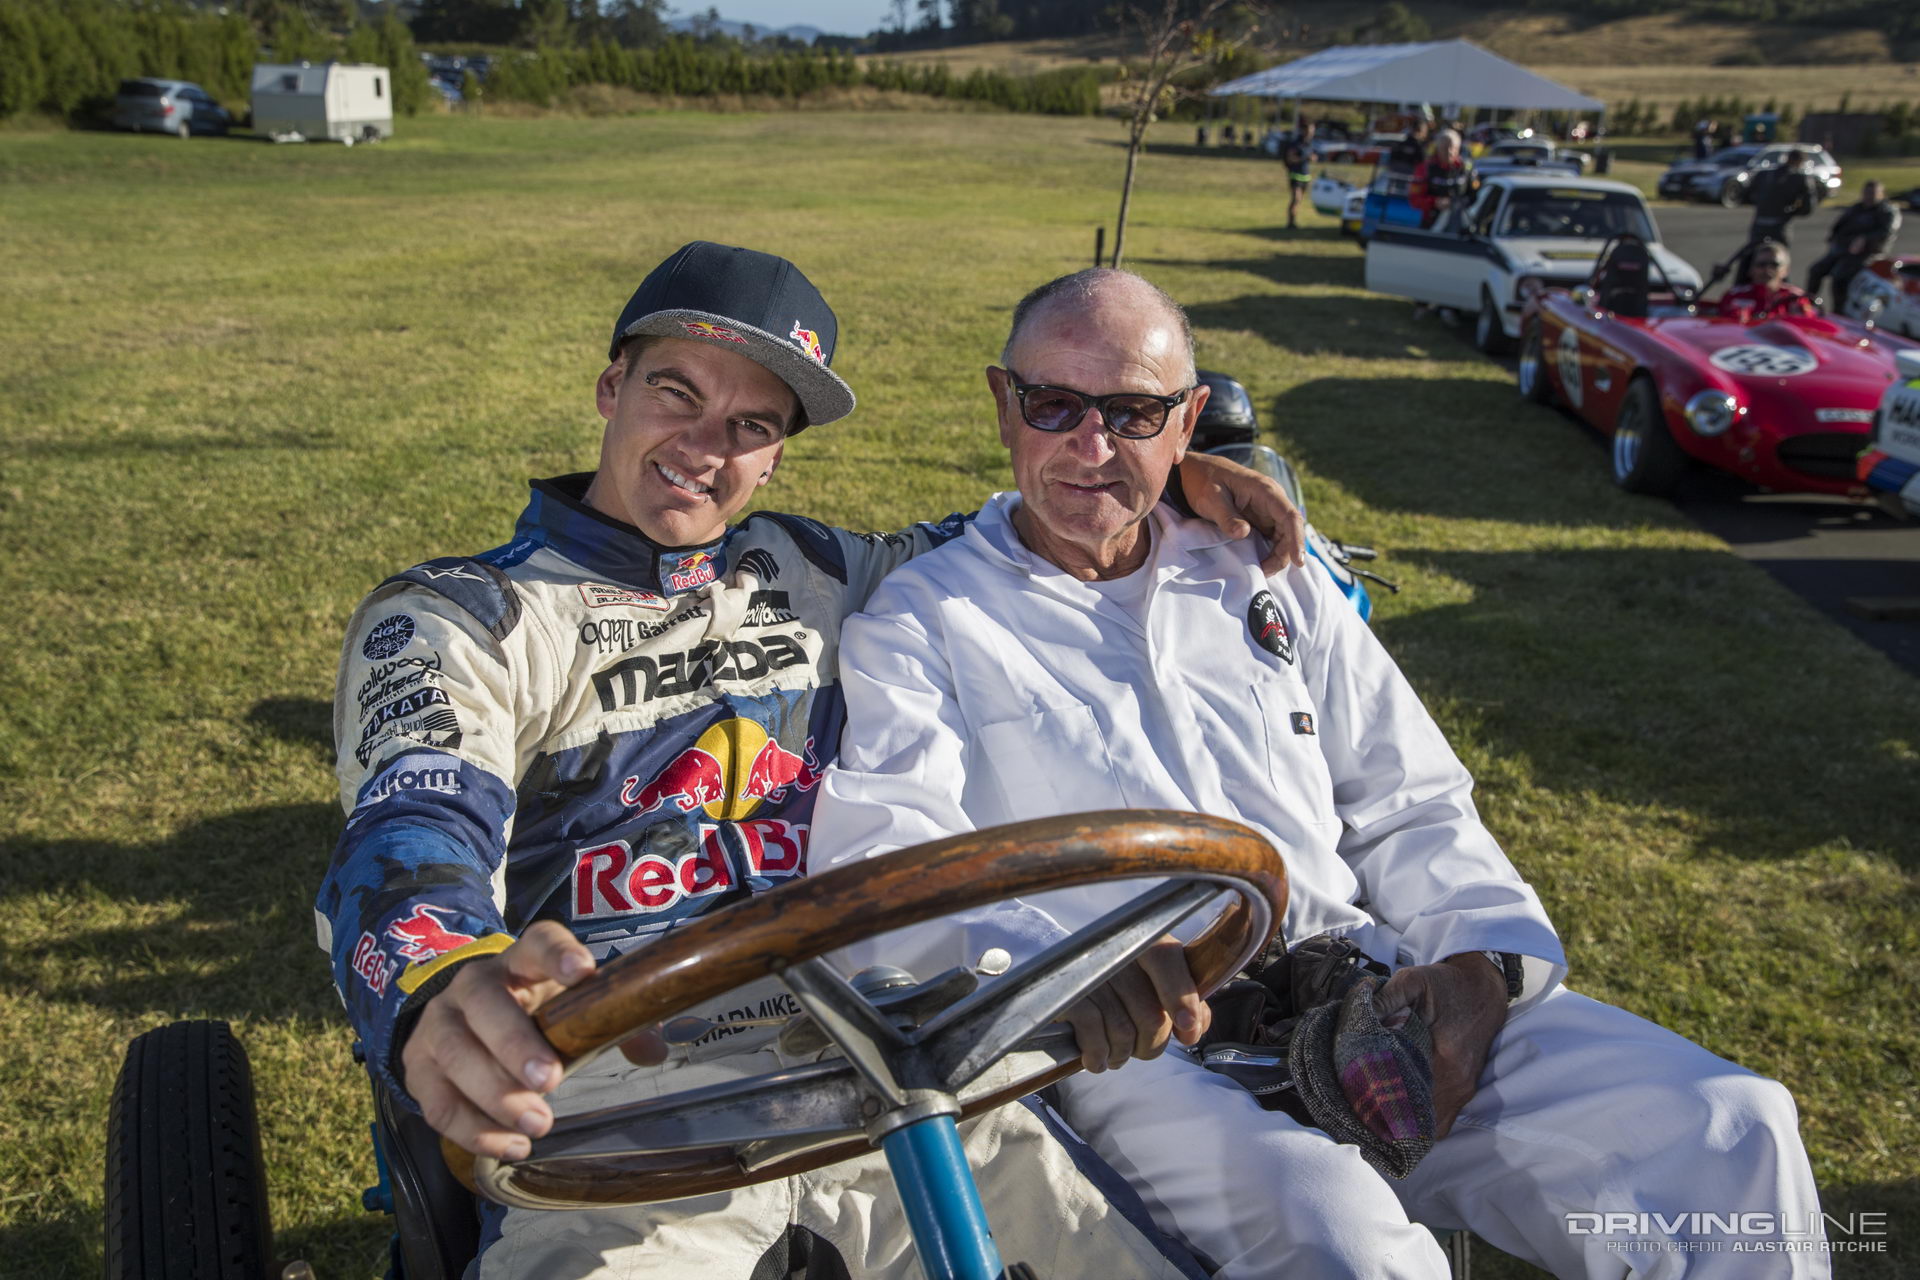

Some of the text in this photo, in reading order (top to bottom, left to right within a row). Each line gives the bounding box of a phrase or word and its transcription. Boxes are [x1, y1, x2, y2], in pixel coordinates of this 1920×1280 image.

[670, 563, 717, 591] Red Bull
[371, 621, 406, 642] NGK
[637, 605, 708, 640] Garrett
[365, 689, 447, 738] TAKATA
[571, 823, 739, 921] Red
